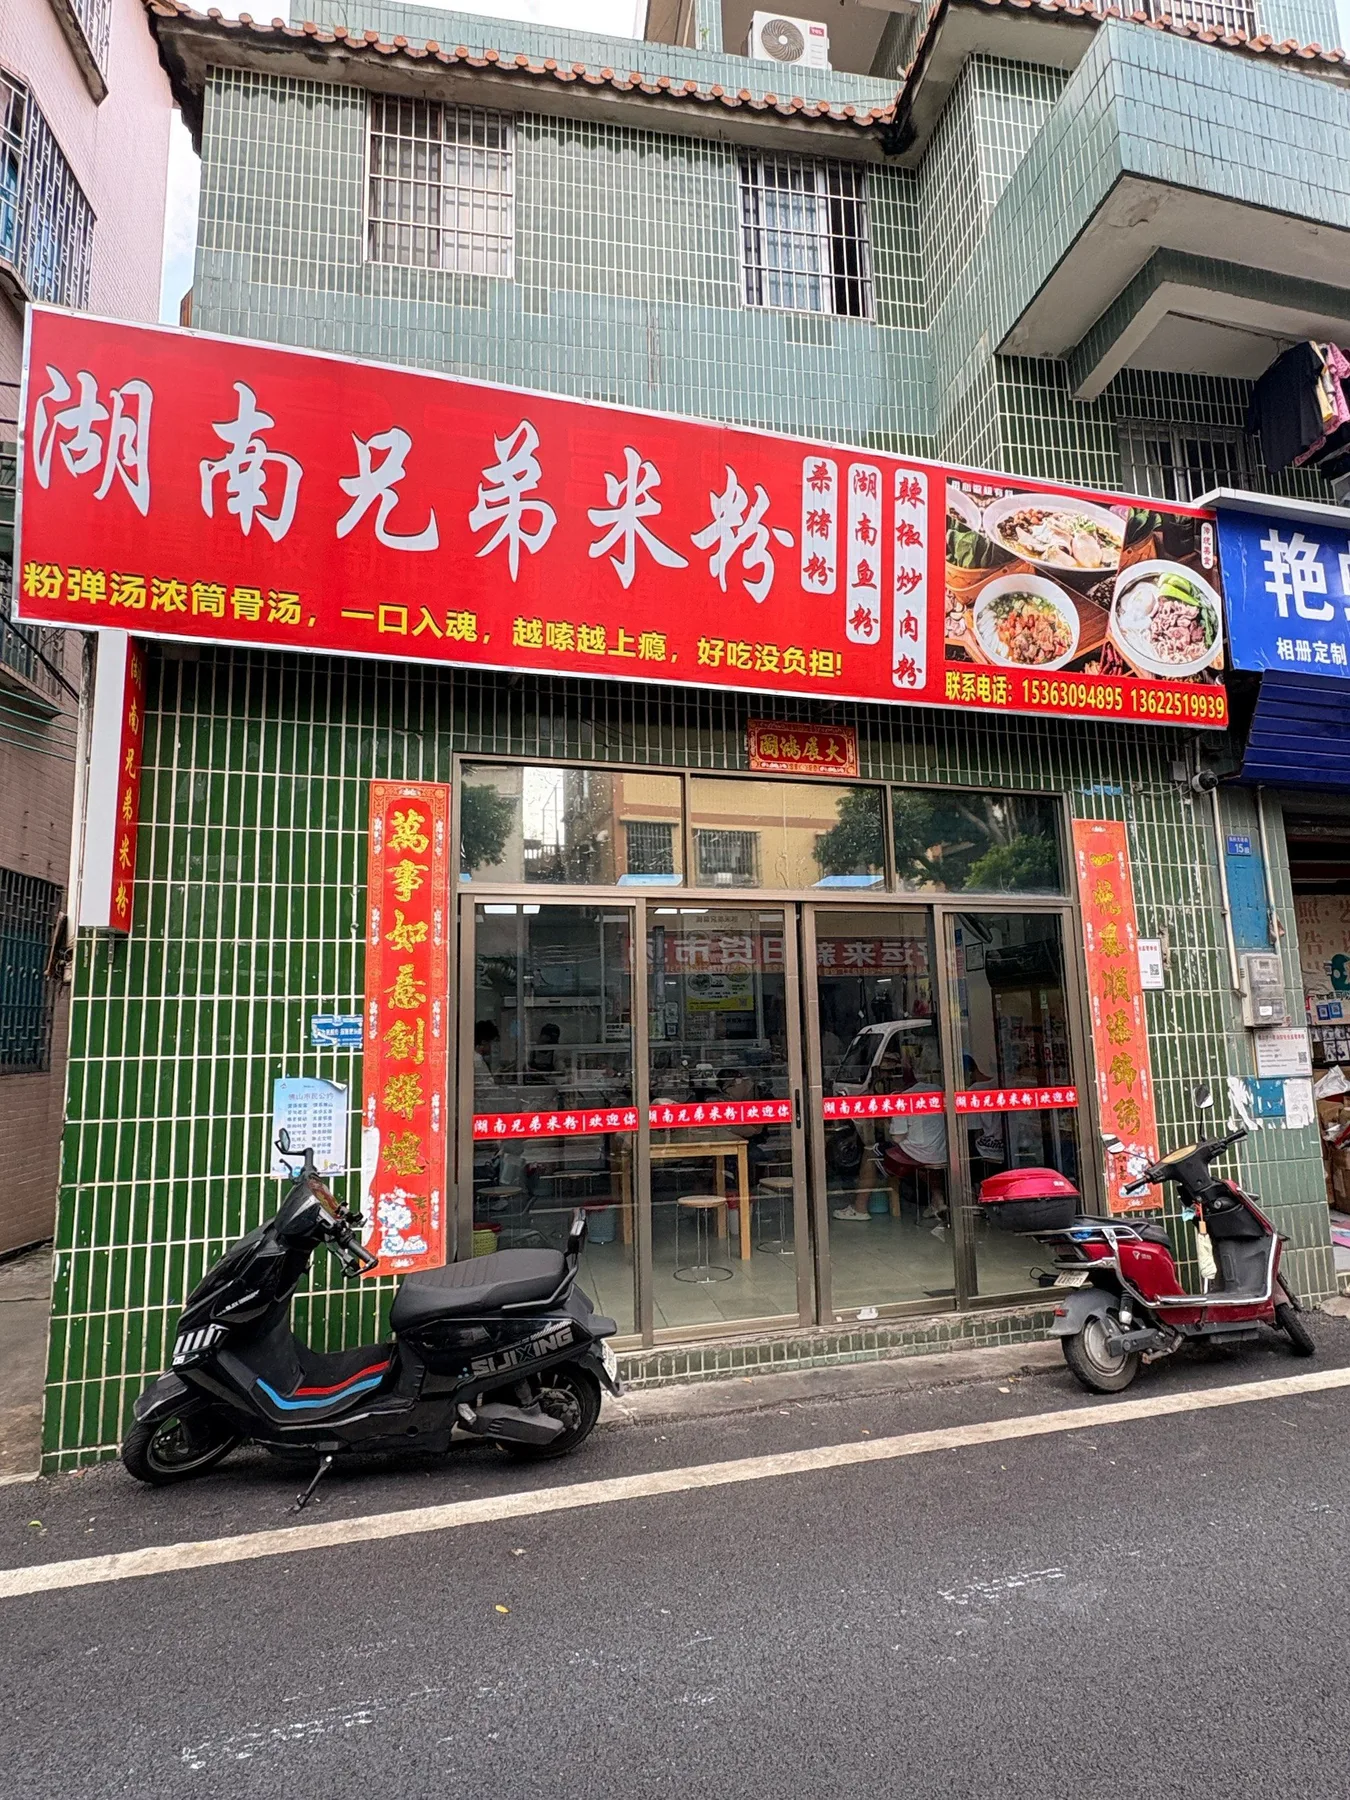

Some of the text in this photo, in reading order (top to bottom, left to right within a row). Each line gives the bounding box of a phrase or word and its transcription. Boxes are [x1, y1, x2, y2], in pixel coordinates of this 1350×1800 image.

[33, 364, 794, 604] 湖南兄弟米粉
[848, 468, 879, 638] 湖南鱼粉
[892, 476, 925, 687] 辣椒炒肉粉
[1276, 636, 1348, 666] 相册定制
[1022, 678, 1123, 712] 15363094895
[1131, 687, 1225, 719] 13622519939
[115, 652, 142, 919] 湖南兄弟米粉
[470, 1326, 574, 1377] SIJIXING
